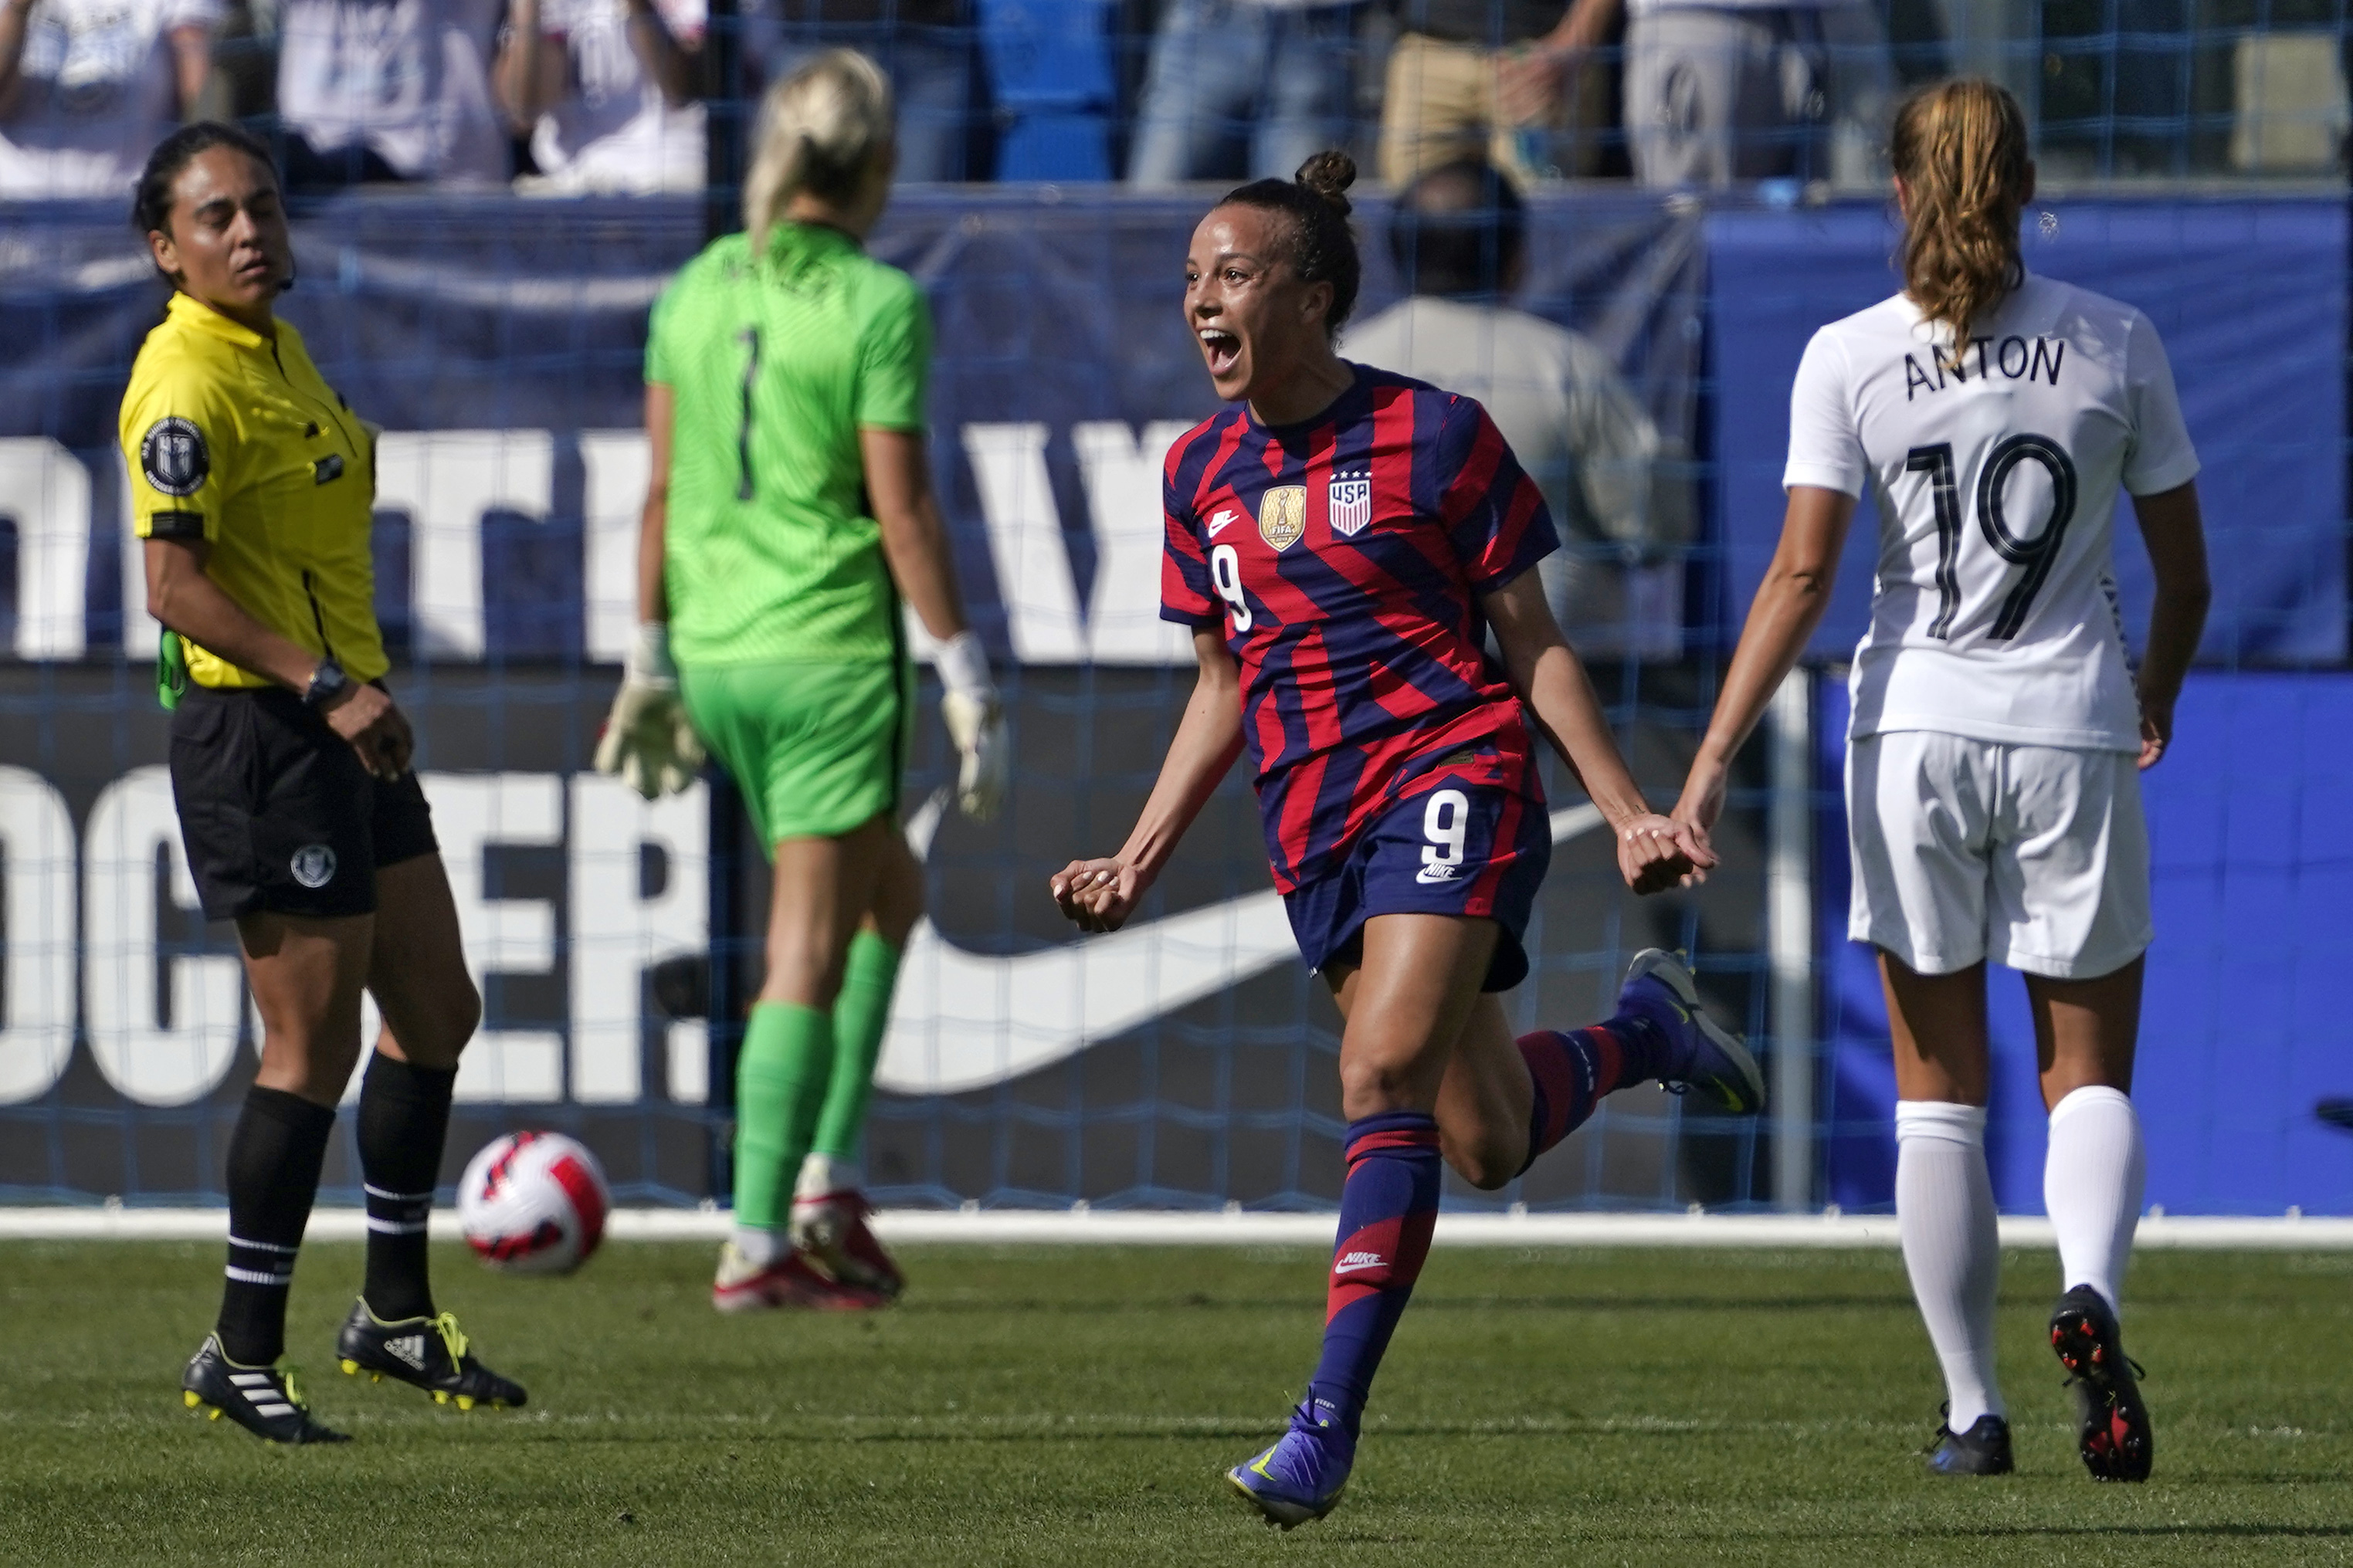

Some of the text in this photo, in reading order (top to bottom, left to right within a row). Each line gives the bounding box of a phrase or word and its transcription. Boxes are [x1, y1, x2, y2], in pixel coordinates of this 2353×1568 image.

[1905, 334, 2065, 401] ANTON
[1332, 483, 1367, 504] USA
[1271, 525, 1292, 534] FIFA
[1906, 432, 2077, 640] 19
[1212, 544, 1252, 632] 9
[1421, 789, 1469, 865] 9
[1424, 863, 1456, 878] NIKE
[1343, 1251, 1381, 1264] NIKE
